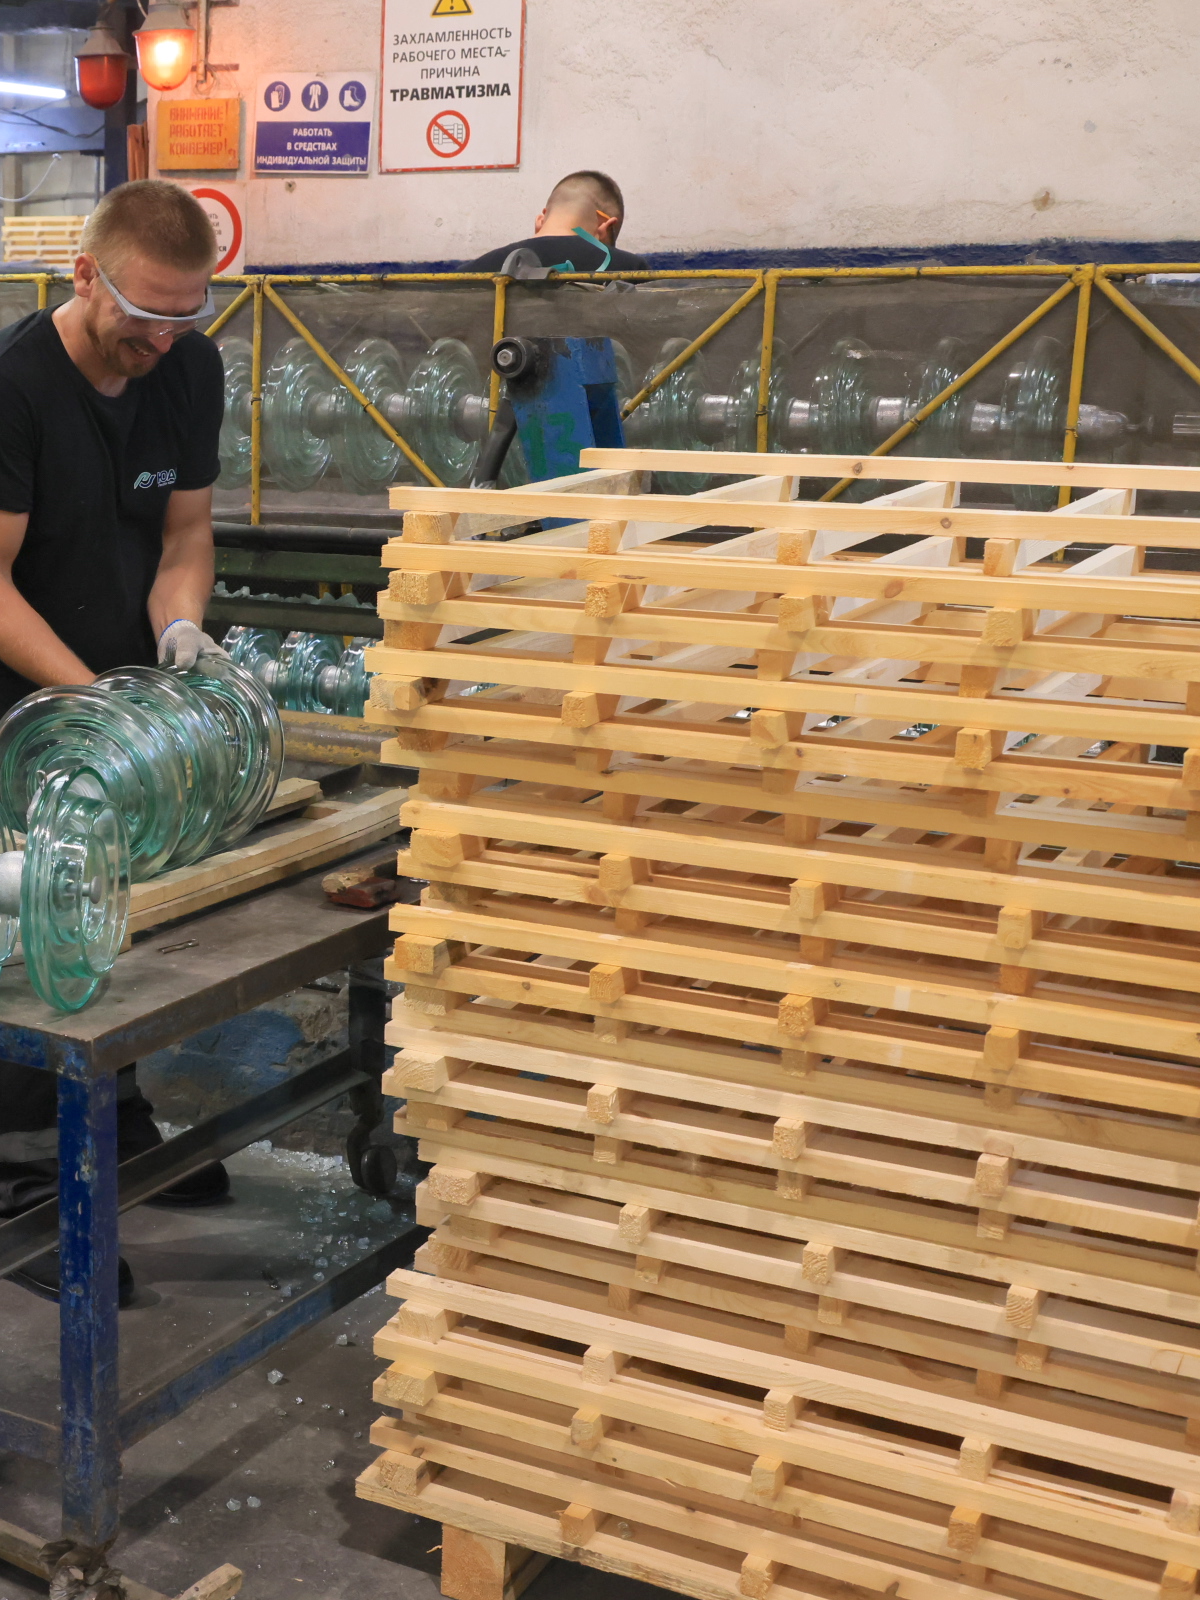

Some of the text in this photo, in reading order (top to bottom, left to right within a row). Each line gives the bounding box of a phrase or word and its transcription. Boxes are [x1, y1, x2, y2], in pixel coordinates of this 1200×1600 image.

[393, 27, 512, 45] ЗАХЛАМЛЕННОСТЬ
[392, 49, 456, 63] РАБОЧЕГО
[420, 65, 481, 79] ПРИЧИНА
[390, 83, 512, 101] ТРАВМАТИЗМА
[293, 128, 333, 137] РАБОТАТЬ
[286, 142, 337, 152] В СРЕДСТВАХ
[256, 155, 367, 166] ИНДИВИДУАЛЬНОЙ ЗАЩИТЫ
